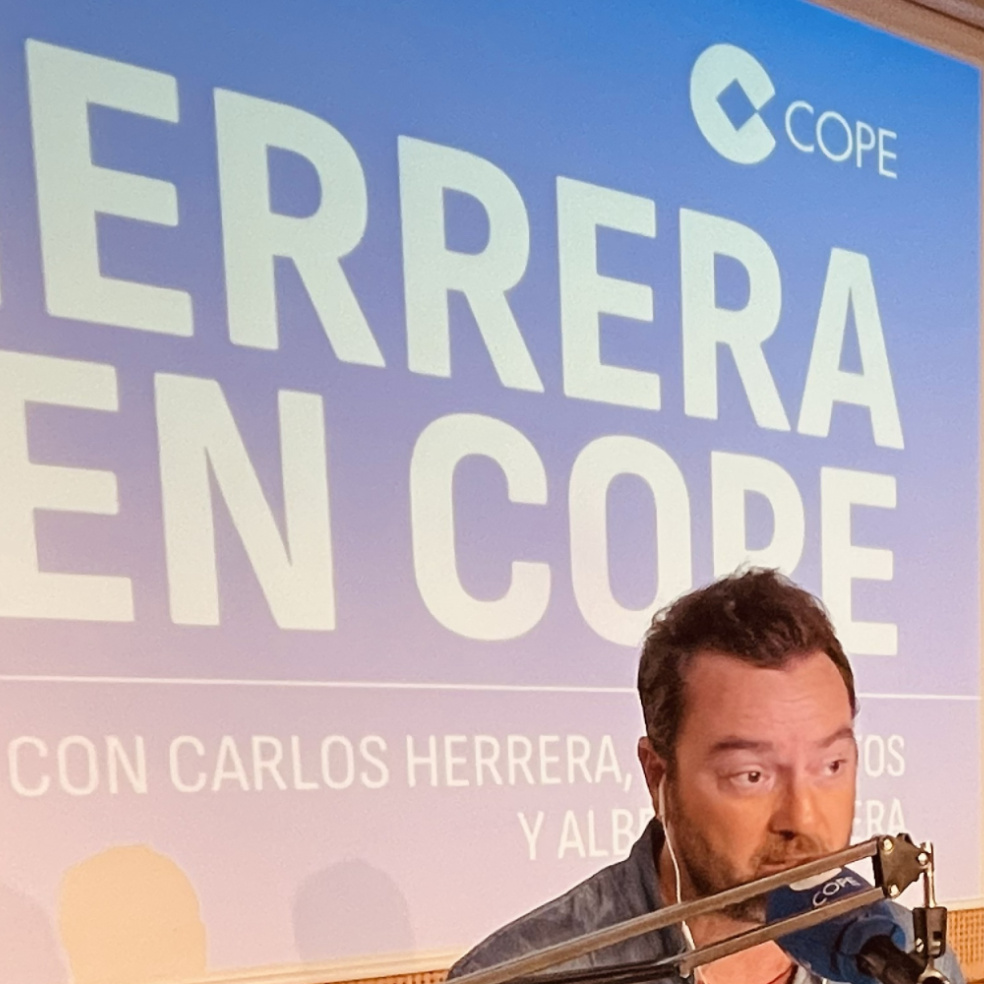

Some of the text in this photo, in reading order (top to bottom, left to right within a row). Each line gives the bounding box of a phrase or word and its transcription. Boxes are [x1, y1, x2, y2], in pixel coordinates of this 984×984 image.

[785, 100, 898, 179] COPE
[0, 37, 905, 450] ERRERA
[0, 350, 899, 657] EN COPE
[7, 735, 148, 798] CON
[168, 734, 391, 793] CARLOS
[406, 734, 632, 793] HERRERA,
[517, 810, 545, 861] Y
